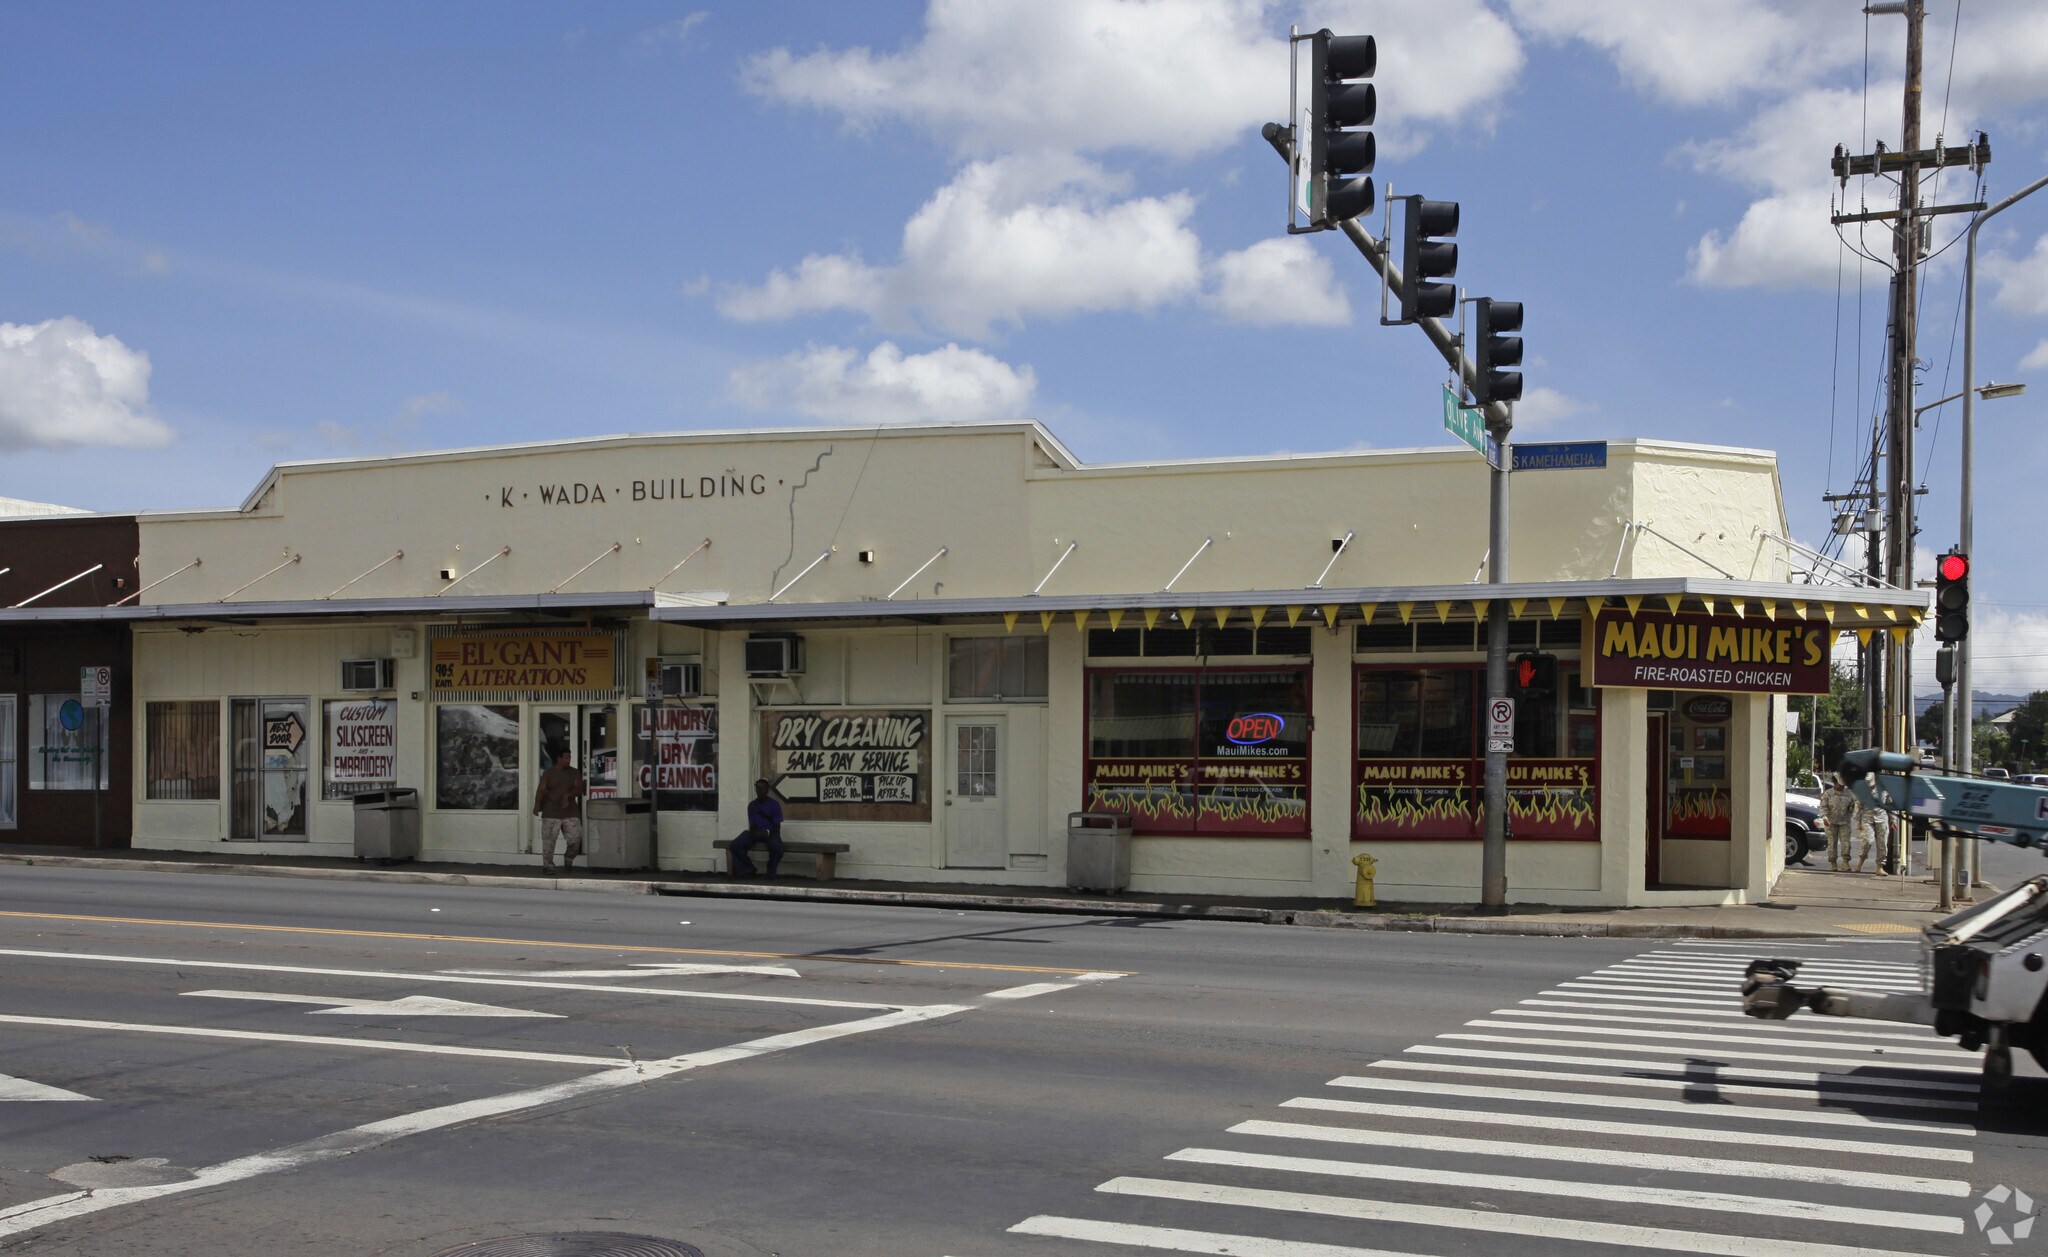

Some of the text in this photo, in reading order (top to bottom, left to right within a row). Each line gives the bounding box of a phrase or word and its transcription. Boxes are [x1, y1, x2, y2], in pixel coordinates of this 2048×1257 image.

[1447, 399, 1468, 433] OLIVE
[1512, 456, 1519, 468] S
[1521, 453, 1595, 468] KAMEHAMEHA
[501, 474, 766, 507] K WADA BUILDING
[1602, 620, 1822, 666] MAUI MIKE'S
[461, 640, 583, 666] EL'GANT
[457, 668, 587, 687] ALTERATIONS
[1634, 666, 1792, 686] FIRE-ROASTED CHICKEN
[339, 705, 388, 721] CUSTOM
[269, 721, 294, 733] NEXT
[774, 716, 922, 748] DRY CLEANING
[1228, 718, 1279, 739] OPEN
[269, 733, 292, 744] DOOR
[336, 725, 393, 747] SILKSCREEN
[661, 743, 692, 764] DRY
[1216, 745, 1289, 756] MauiMikes.com
[334, 756, 394, 777] EMBROIDERY
[785, 750, 910, 772] SAME DAY SERVICE
[640, 766, 713, 789] CEANING
[1096, 763, 1189, 778] MAUI MIKE'S
[1204, 764, 1301, 779] MAUI MIKE'S
[1364, 765, 1465, 780] MAUI MIKE'S
[1531, 766, 1588, 780] MIKE'S
[825, 776, 857, 787] DROP OFF
[878, 775, 907, 787] PICK UP
[822, 787, 847, 800] BEFORE
[876, 787, 898, 799] AFTER
